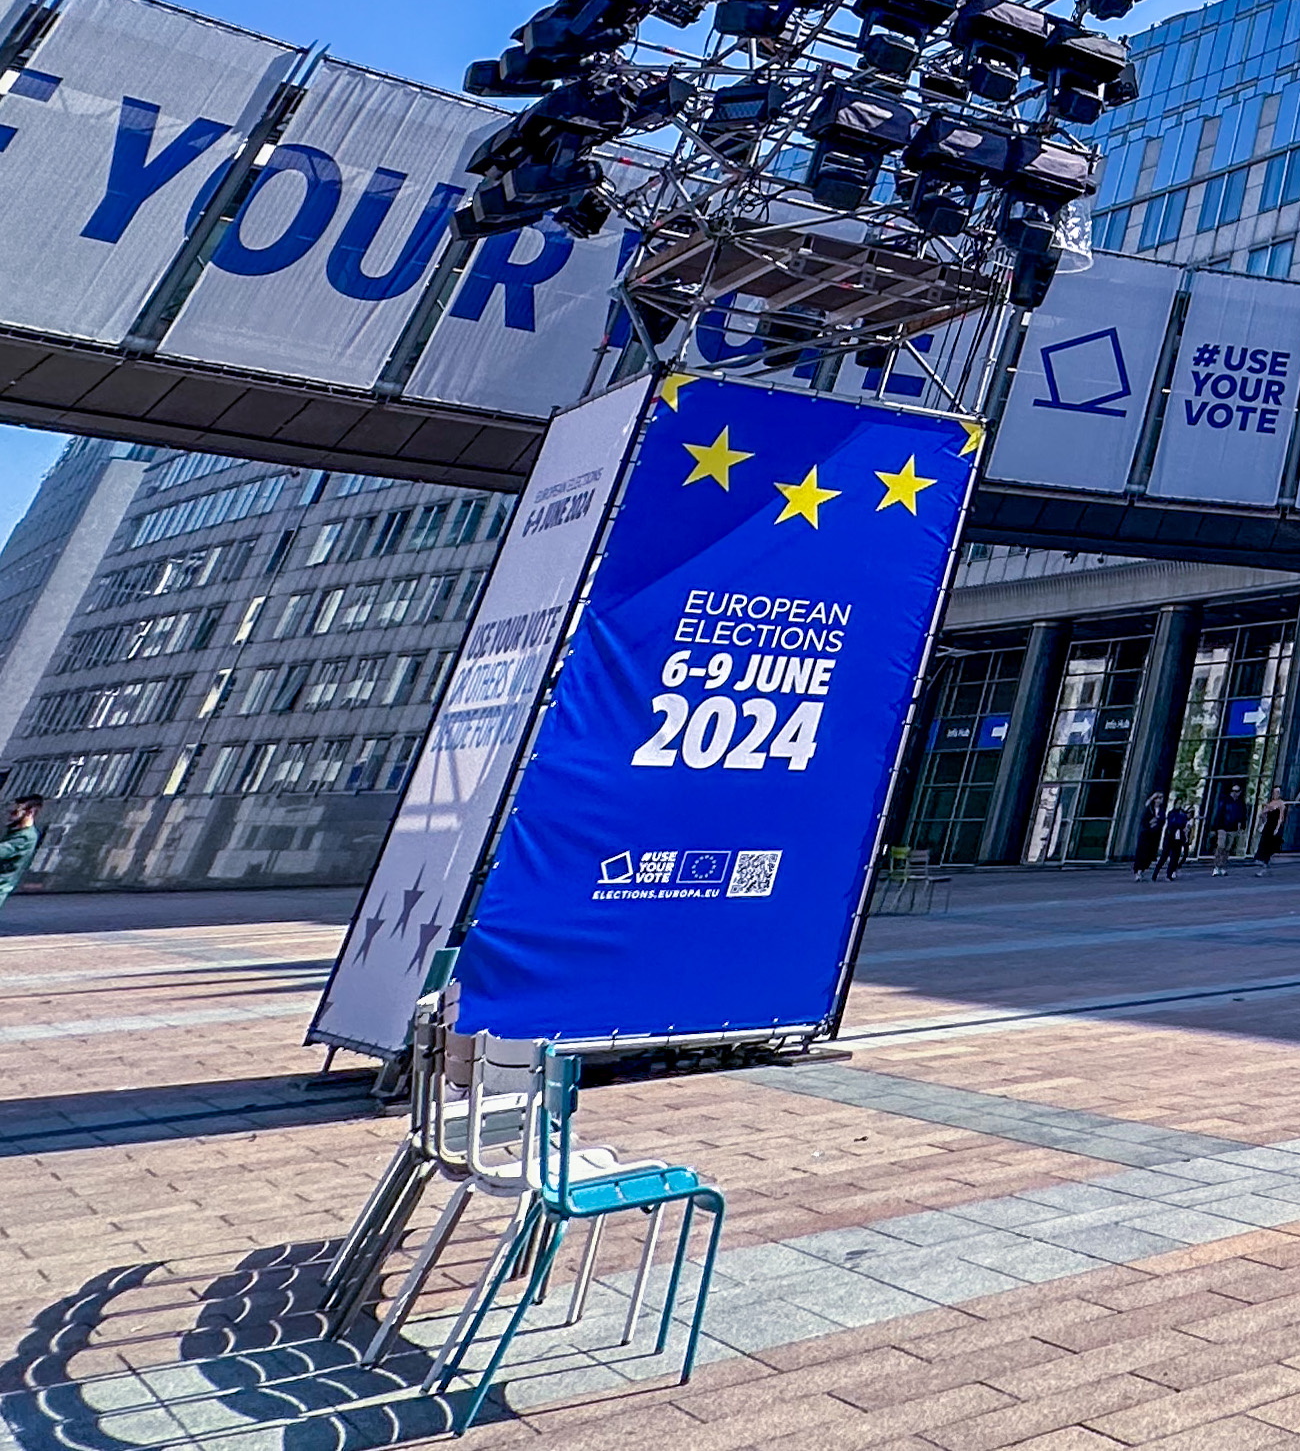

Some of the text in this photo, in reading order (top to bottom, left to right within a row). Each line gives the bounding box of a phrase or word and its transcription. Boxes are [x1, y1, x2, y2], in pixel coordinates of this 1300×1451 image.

[80, 96, 573, 332] YOUR
[1193, 344, 1290, 377] #USE
[1192, 371, 1285, 405] YOUR
[1185, 399, 1279, 434] VOTE
[685, 590, 851, 625] EUROPEAN
[467, 605, 563, 660] USE YOUR VOTE
[675, 618, 844, 652] ELECTIONS
[448, 665, 474, 706] OR
[465, 659, 514, 703] OTHERS
[733, 655, 837, 695] JUNE
[631, 694, 824, 770] 2024
[638, 862, 676, 873] YOUR
[640, 852, 678, 862] #USE
[592, 889, 720, 900] ELECTIONS.EUROPA.EU
[635, 873, 671, 884] VOTE
